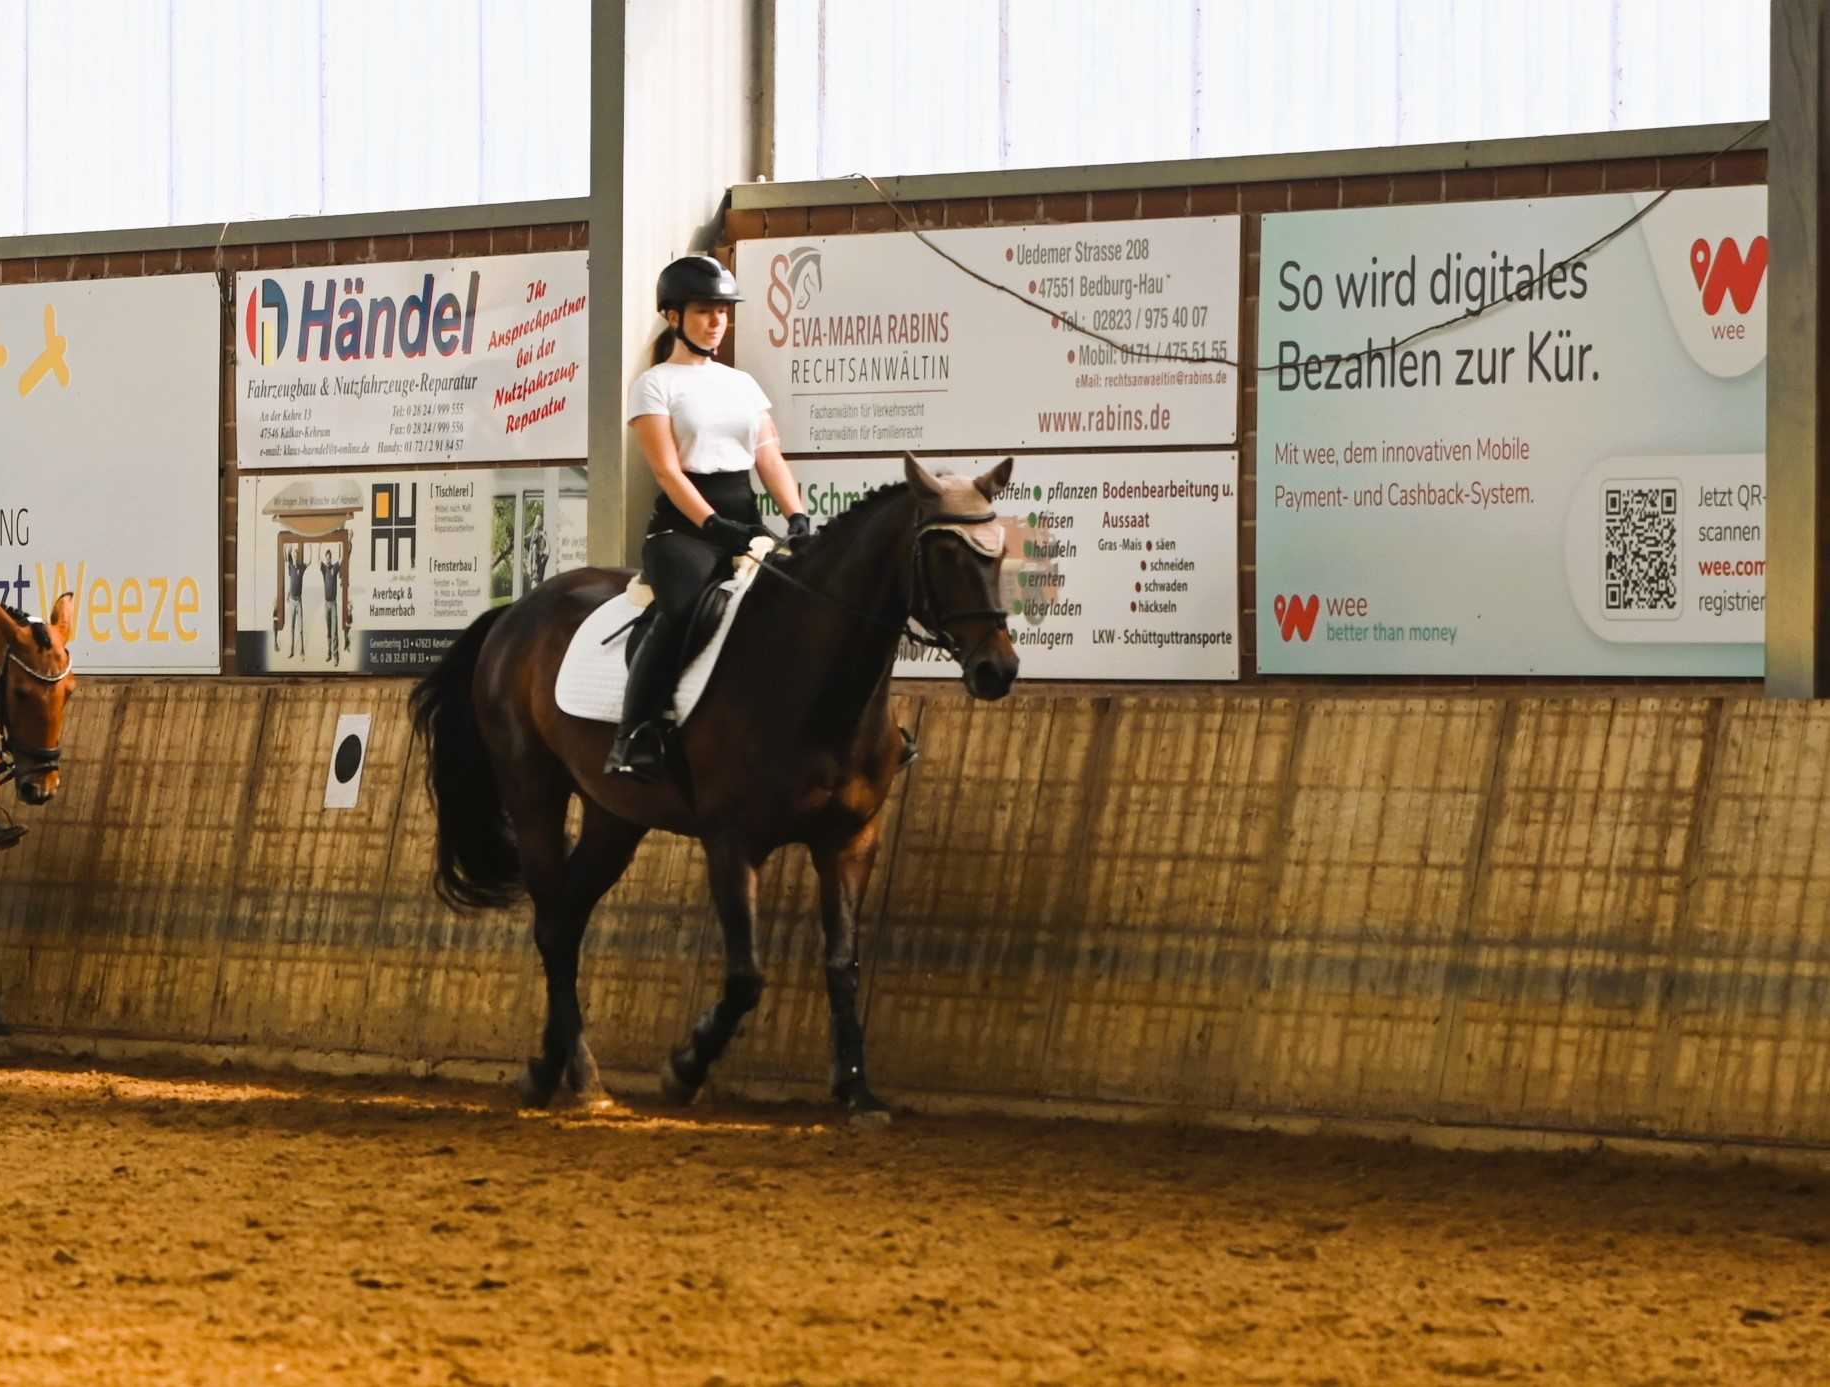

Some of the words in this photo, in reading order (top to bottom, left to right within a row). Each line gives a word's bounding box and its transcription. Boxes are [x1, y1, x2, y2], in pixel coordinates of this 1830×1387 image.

[1017, 244, 1071, 265] Uedemer
[1075, 241, 1122, 263] Strasse
[1126, 238, 1149, 260] 208
[526, 280, 547, 303] Ihr
[1039, 278, 1075, 298] 47551
[1079, 275, 1163, 300] Bedburg-Hau
[1278, 260, 1323, 313] So
[1336, 254, 1416, 309] wird
[1430, 248, 1588, 317] digitales
[296, 270, 480, 363] Händel
[488, 296, 586, 352] Ansprechpartner
[1093, 309, 1132, 331] 02823
[1145, 308, 1168, 329] 975
[1172, 307, 1188, 328] 40
[1192, 306, 1208, 327] 07
[793, 314, 882, 347] EVA-MARIA
[888, 312, 949, 344] RABINS
[1711, 322, 1745, 340] wee
[517, 349, 533, 369] bei
[537, 339, 556, 363] der
[1079, 344, 1117, 366] Mobil:
[1121, 343, 1150, 364] 0171
[1165, 341, 1187, 363] 475
[1278, 337, 1440, 392] Bezahlen
[1455, 348, 1514, 387] zur
[1528, 330, 1600, 383] Kür.
[791, 350, 949, 384] RECHTSANWÄLTIN
[247, 377, 317, 402] Fahrzeugbau
[334, 373, 478, 400] Nutzfahrzeuge-Reparatur
[493, 361, 579, 409] Nutzfahrzeug-
[506, 396, 567, 434] Reparatur
[1038, 403, 1170, 433] www.rabins.de
[1275, 441, 1299, 465] Mit
[1305, 449, 1339, 467] wee,
[1343, 441, 1377, 464] dem
[1382, 440, 1472, 463] innovativen
[1476, 437, 1530, 460] Mobile
[435, 484, 469, 497] Tischlerei
[1047, 481, 1098, 504] pflanzen
[1102, 479, 1219, 502] Bodenbearbeitung
[1275, 485, 1348, 512] Payment-
[1353, 483, 1383, 506] und
[1387, 481, 1534, 510] Cashback-System.
[1698, 485, 1733, 507] Jetzt
[1037, 511, 1074, 529] fräsen
[1102, 511, 1150, 529] Aussaat
[1098, 538, 1117, 551] Gras
[1155, 538, 1176, 551] säen
[1698, 525, 1760, 542] scannen
[1034, 539, 1077, 558] häufeln
[433, 559, 472, 572] Fensterbau
[1150, 558, 1195, 571] schneiden
[1028, 571, 1065, 588] ernten
[1144, 580, 1188, 592] schwaden
[34, 560, 200, 644] Weeze
[369, 605, 415, 618] Hammerbach
[1024, 599, 1082, 617] überladen
[1138, 600, 1177, 613] häckseln
[1326, 597, 1368, 617] wee
[1020, 629, 1074, 650] einlagern
[1092, 630, 1115, 645] LKW
[1123, 628, 1232, 648] Schüttguttransporte
[1326, 622, 1368, 642] better
[1373, 622, 1404, 641] than
[1409, 625, 1457, 645] money
